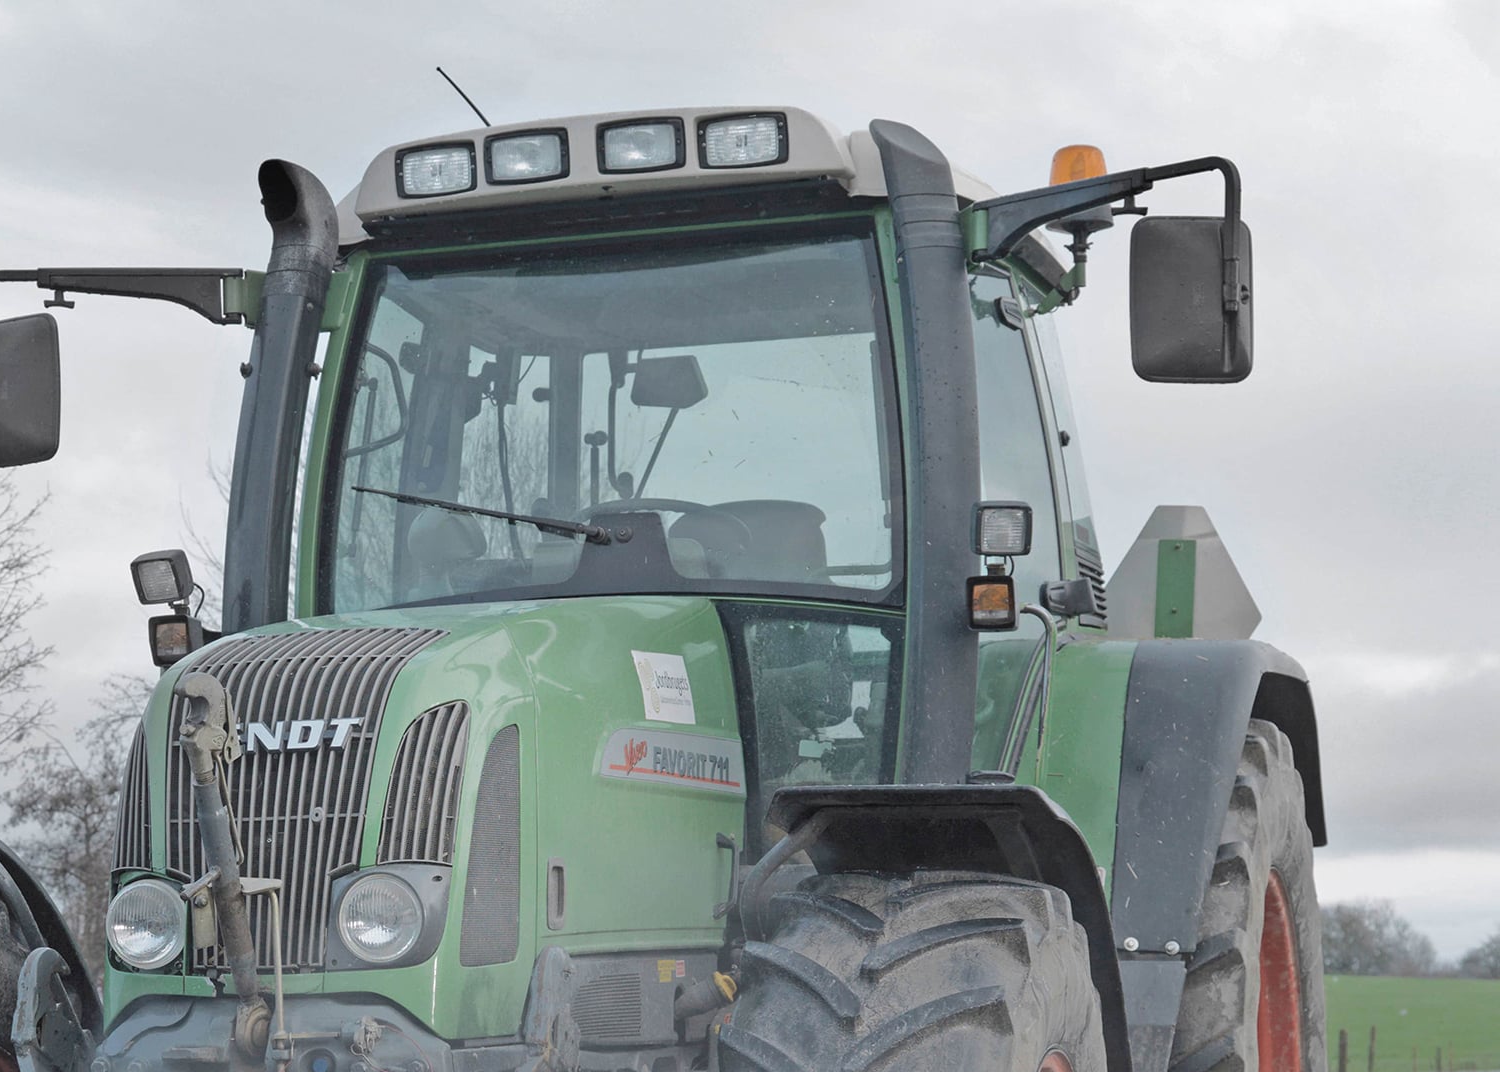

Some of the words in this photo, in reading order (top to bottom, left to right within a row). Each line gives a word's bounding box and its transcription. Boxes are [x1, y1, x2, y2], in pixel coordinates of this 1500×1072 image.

[236, 717, 365, 752] NDT
[653, 745, 707, 781] FAVORIT
[708, 754, 730, 783] 711
